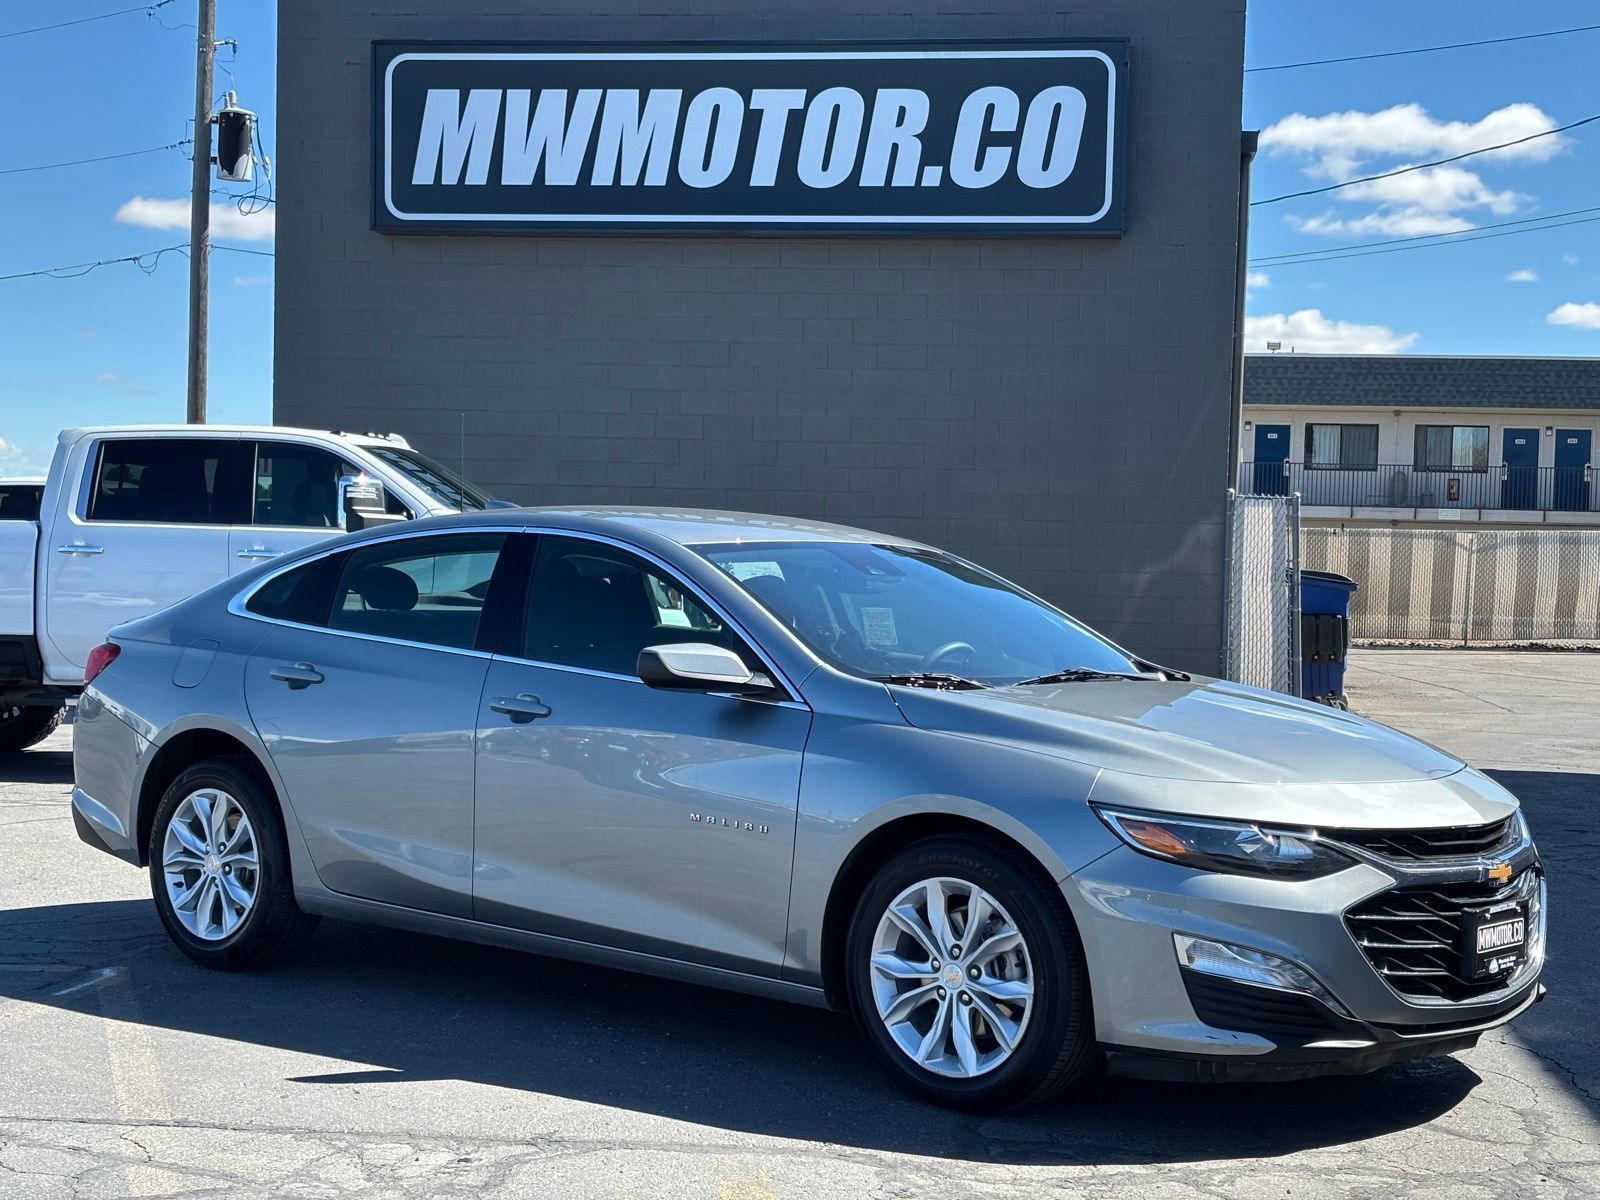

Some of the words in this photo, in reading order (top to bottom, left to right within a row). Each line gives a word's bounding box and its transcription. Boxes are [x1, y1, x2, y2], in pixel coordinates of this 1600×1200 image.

[411, 86, 1087, 188] MWMOTOR.CO
[690, 813, 768, 834] MALIBU
[1479, 922, 1523, 949] MWMOTOR.CO
